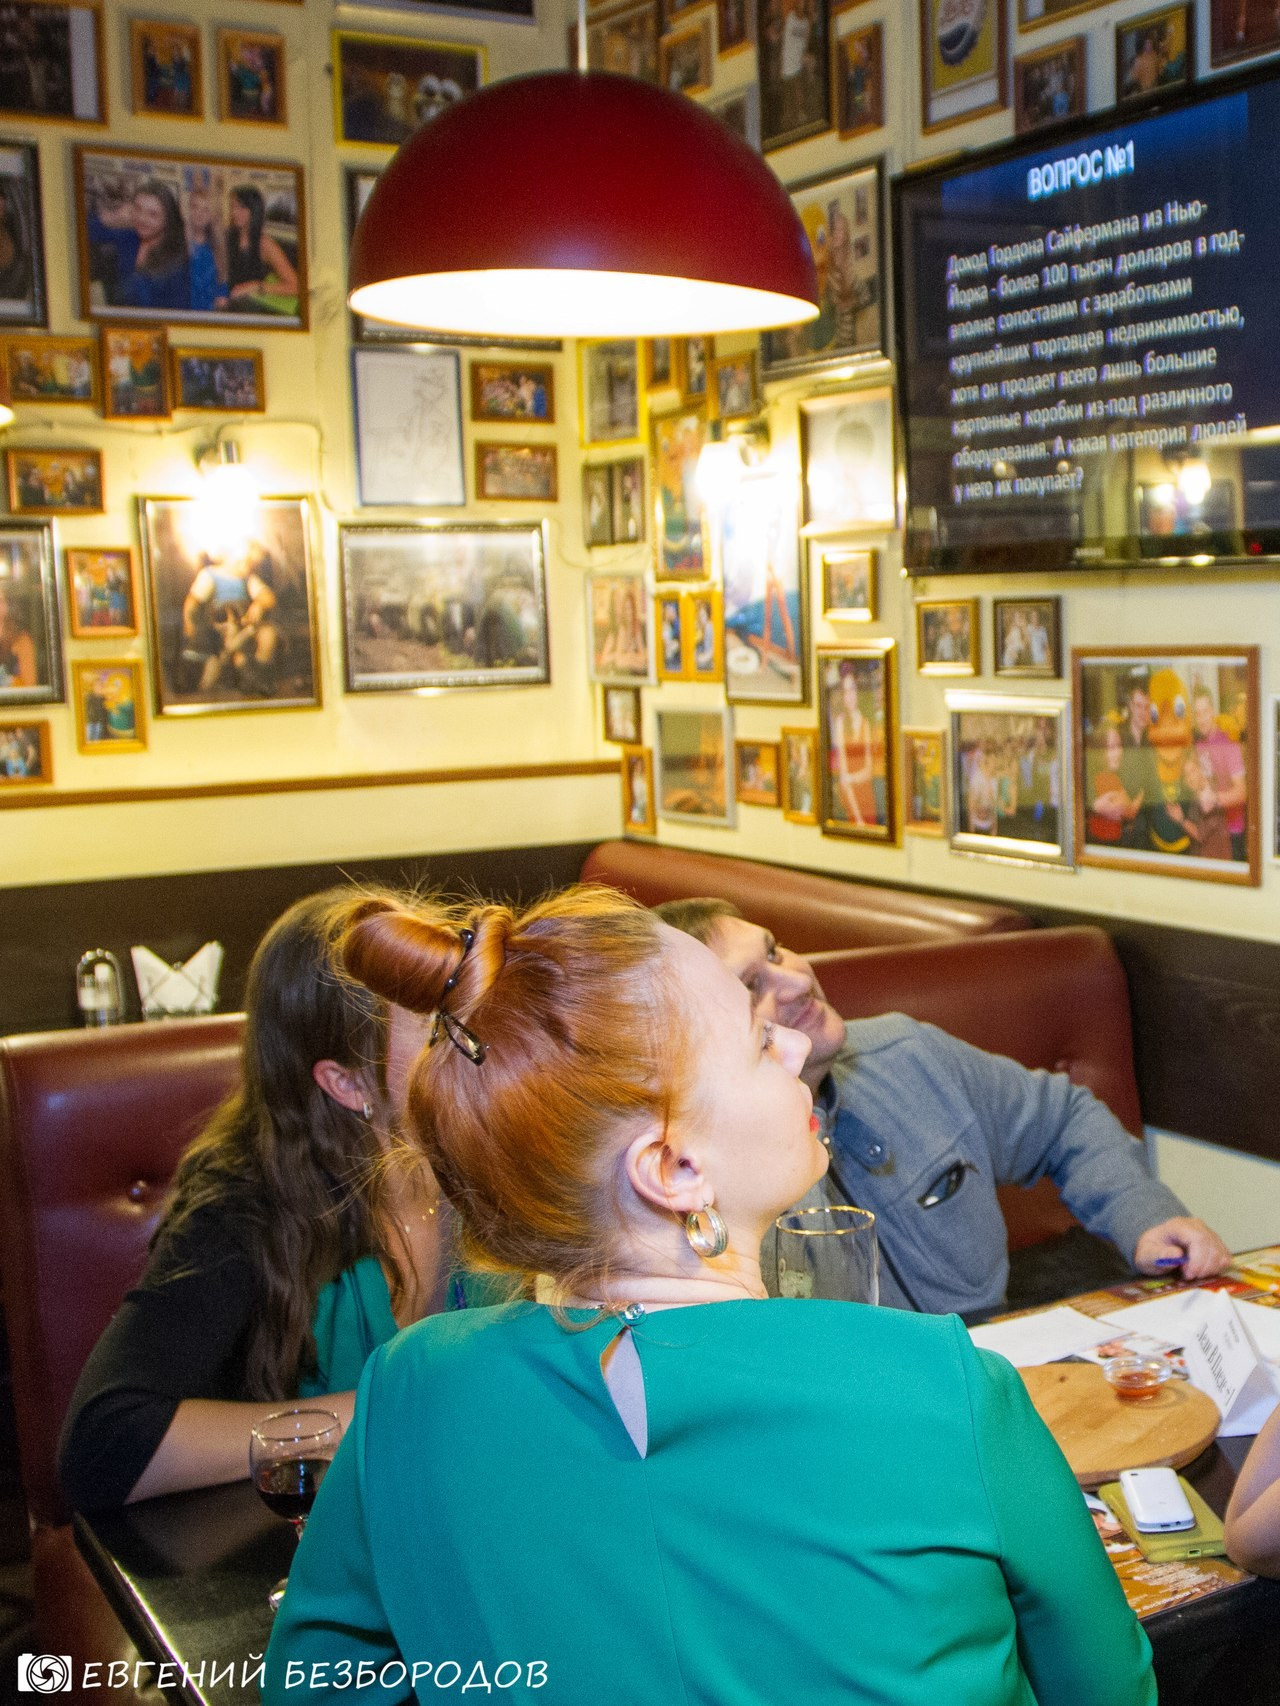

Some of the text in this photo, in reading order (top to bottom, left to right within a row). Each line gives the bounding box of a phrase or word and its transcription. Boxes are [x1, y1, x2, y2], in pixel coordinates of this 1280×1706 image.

[1027, 139, 1135, 201] ВОПРОС №1
[946, 200, 1208, 281] Доход Гордона Сайфермана из Нью-
[947, 282, 989, 311] Йорка
[997, 273, 1039, 299] более
[1042, 262, 1069, 288] 100
[1070, 257, 1113, 283] тысяч
[1115, 239, 1193, 276] долларов
[1195, 236, 1208, 258] в
[949, 276, 1193, 343] вполне сопоставим с заработками
[950, 305, 1246, 377] крупнейших торговцев недвижимостью,
[951, 346, 1218, 406] хотя он продает всего лишь большие
[952, 382, 1234, 440] картонные коробки из-под различного
[1067, 433, 1108, 457] какая
[1109, 424, 1188, 451] категория
[1013, 465, 1085, 498] покупает?
